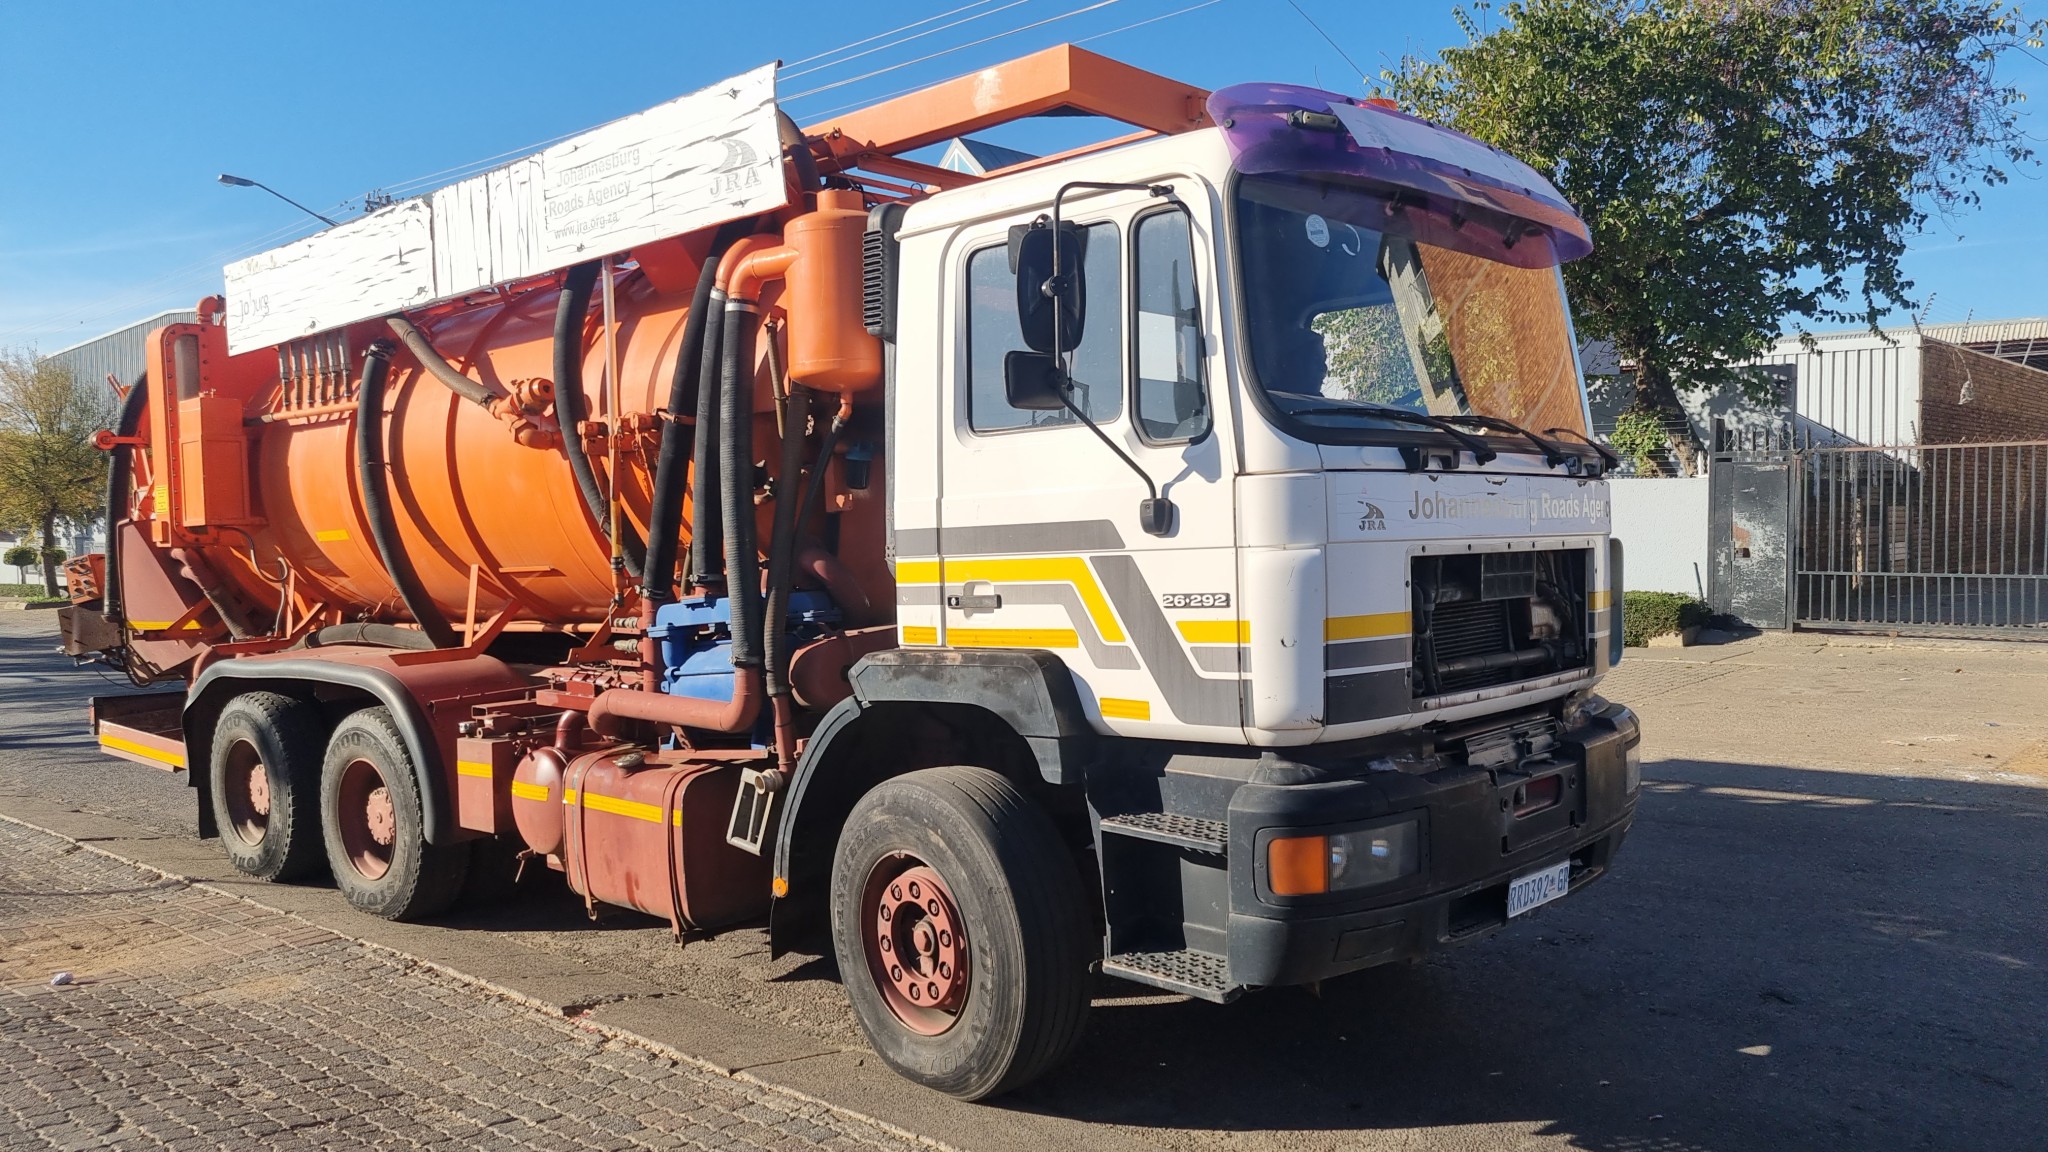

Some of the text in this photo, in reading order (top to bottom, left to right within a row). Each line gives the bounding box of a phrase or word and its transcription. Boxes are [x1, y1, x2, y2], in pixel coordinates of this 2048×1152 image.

[557, 147, 640, 187] Johannesburg
[710, 166, 762, 198] JRA
[549, 180, 631, 218] Roads Agency
[554, 212, 619, 239] www.jra.org.za
[1542, 493, 1580, 518] Roads
[1359, 520, 1386, 531] JRA
[1509, 874, 1550, 913] RRD392
